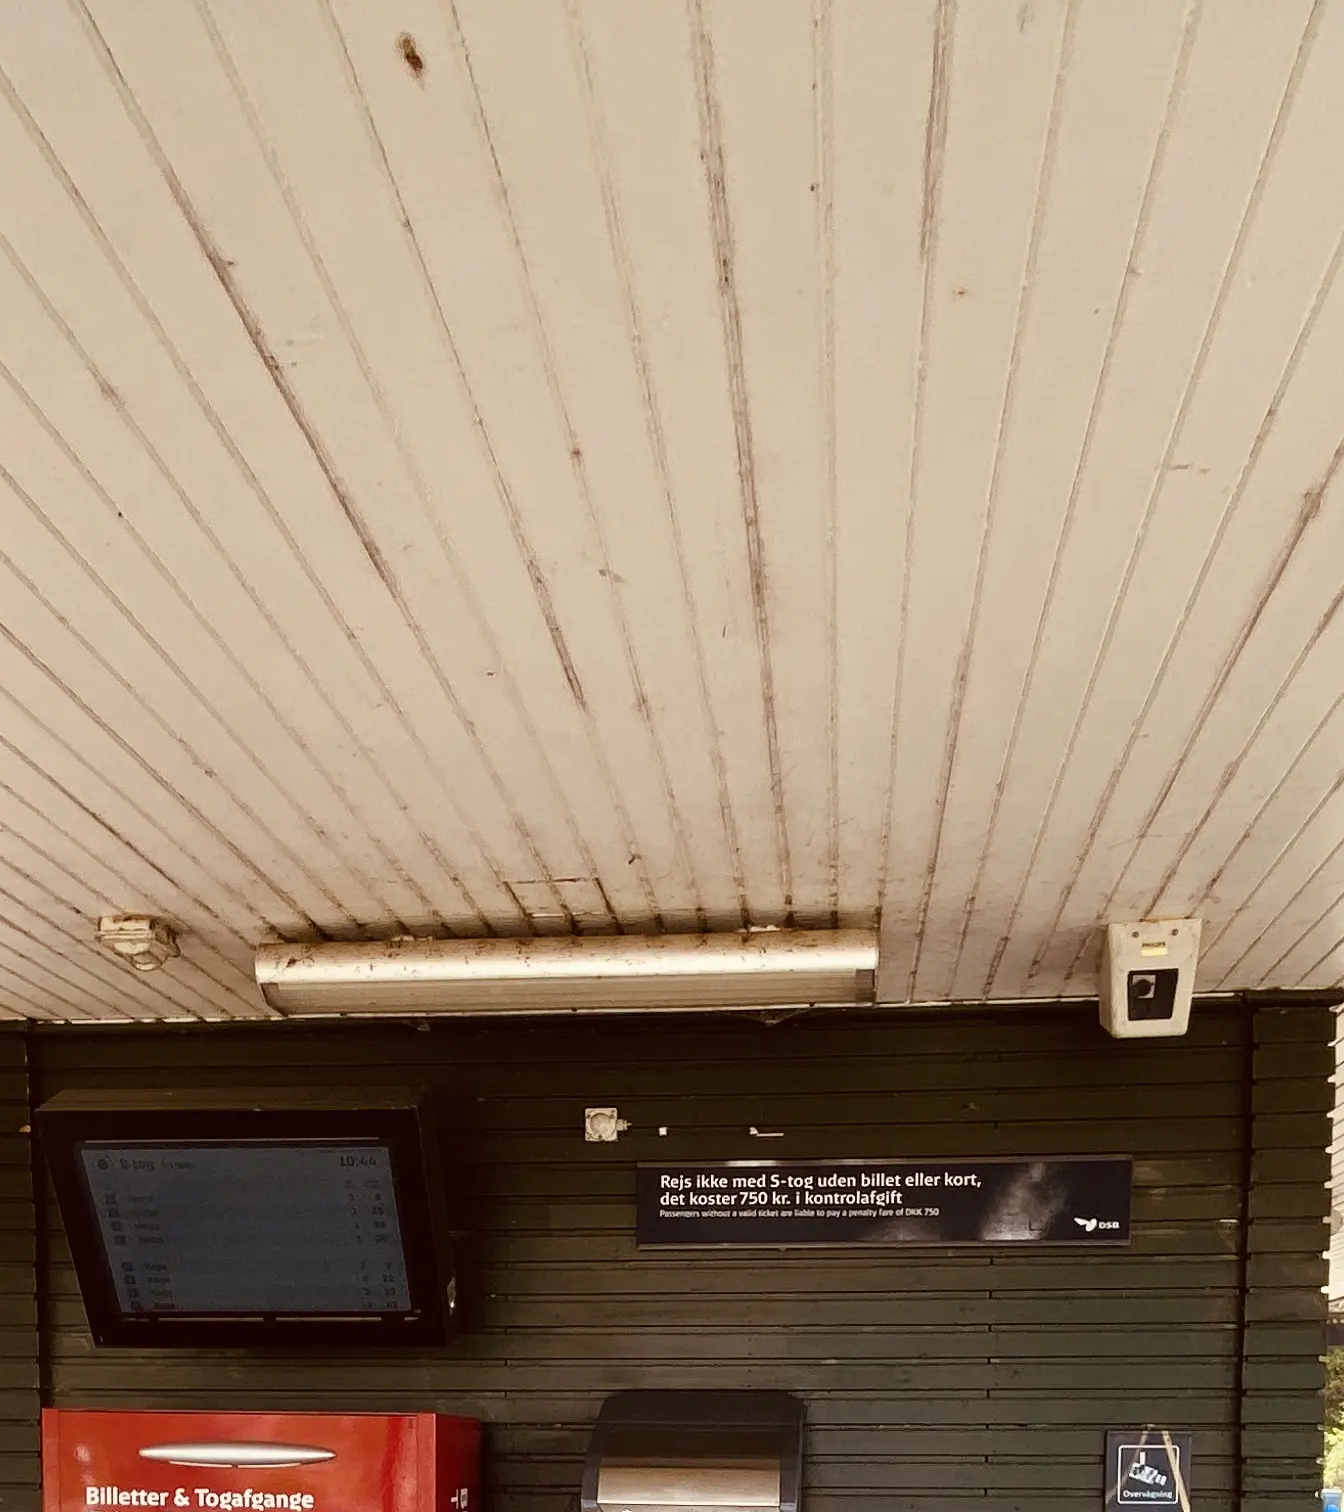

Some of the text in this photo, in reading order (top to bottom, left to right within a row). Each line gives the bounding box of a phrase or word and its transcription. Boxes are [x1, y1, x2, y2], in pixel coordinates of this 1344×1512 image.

[660, 1172, 982, 1191] Rejs ikke med S-tog uden billet eller kort,
[660, 1190, 903, 1207] det koster 750 kr. i kontrolafgift
[701, 1209, 731, 1218] without
[732, 1210, 737, 1218] a
[739, 1209, 757, 1217] valid
[758, 1209, 779, 1217] ticket
[794, 1209, 815, 1217] liable
[816, 1209, 825, 1217] to
[826, 1210, 841, 1218] pay
[848, 1208, 877, 1218] penalty
[878, 1208, 894, 1216] fare
[895, 1208, 904, 1216] of
[905, 1208, 923, 1216] DKK
[924, 1207, 940, 1216] 750
[85, 1486, 314, 1511] Billetter & Togafgange
